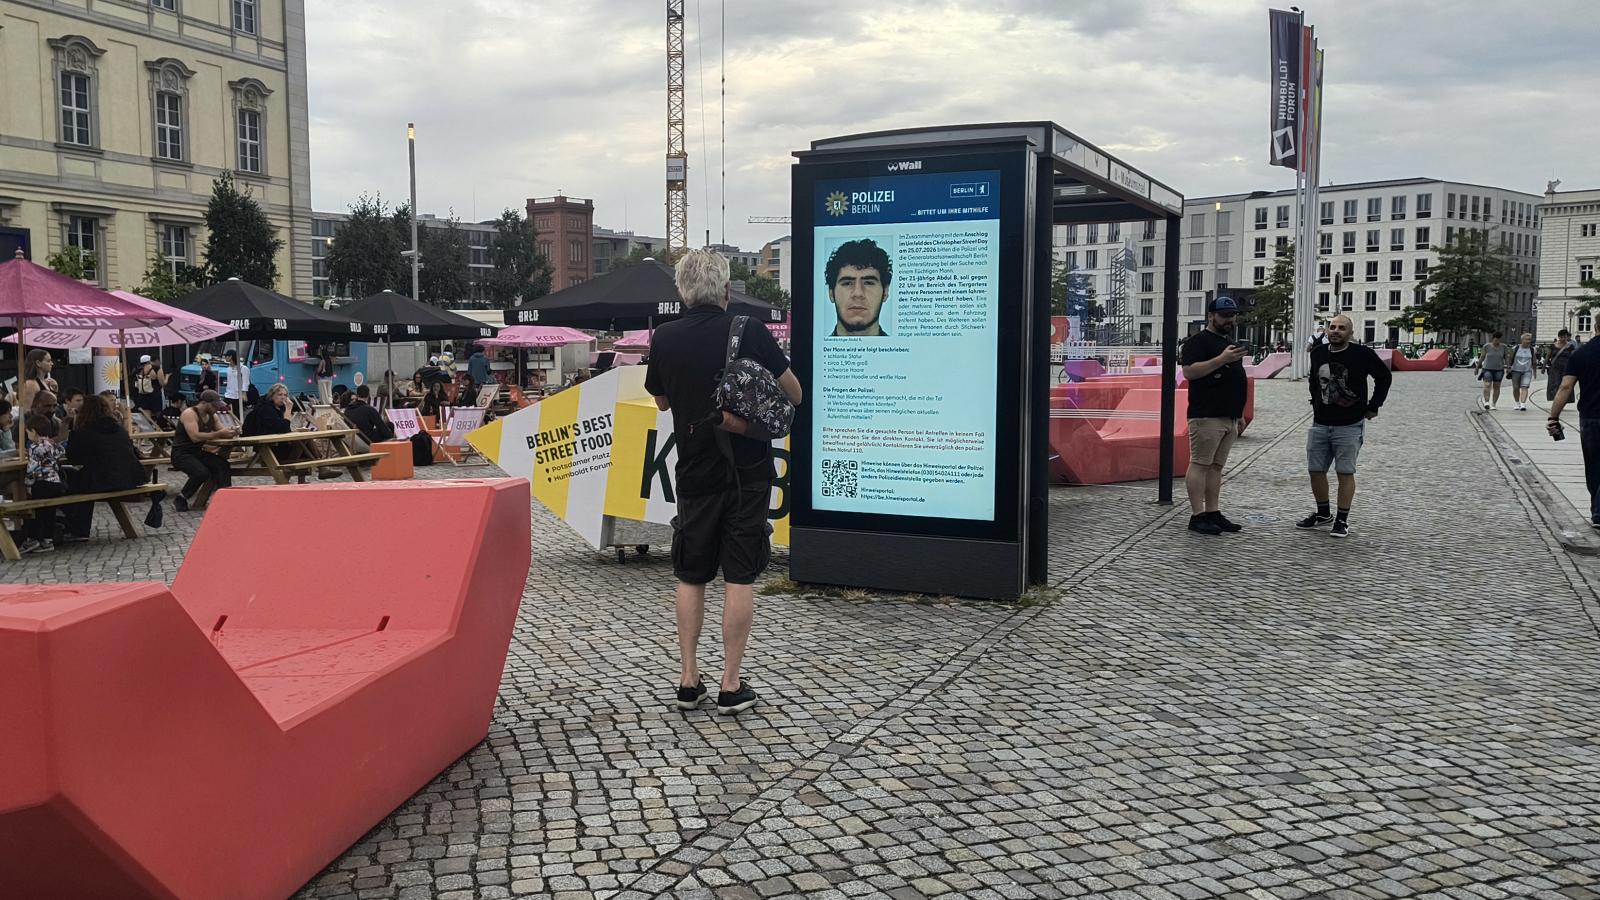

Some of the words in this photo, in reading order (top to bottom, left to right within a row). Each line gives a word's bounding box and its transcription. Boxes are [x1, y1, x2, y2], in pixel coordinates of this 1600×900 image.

[1279, 58, 1288, 120] HUMBOLDT
[1287, 82, 1296, 120] FORUM
[899, 161, 921, 170] Wall
[852, 190, 895, 203] POLIZEI
[852, 204, 880, 214] BERLIN
[45, 302, 125, 316] KERB
[395, 420, 414, 430] KERB
[526, 422, 581, 449] BERLIN'S
[583, 414, 612, 434] BEST
[536, 441, 578, 464] STREET
[581, 432, 612, 452] FOOD
[552, 457, 590, 472] Potsdamer
[592, 452, 610, 461] Platz
[554, 467, 588, 481] Humboldt
[590, 462, 613, 471] Forum
